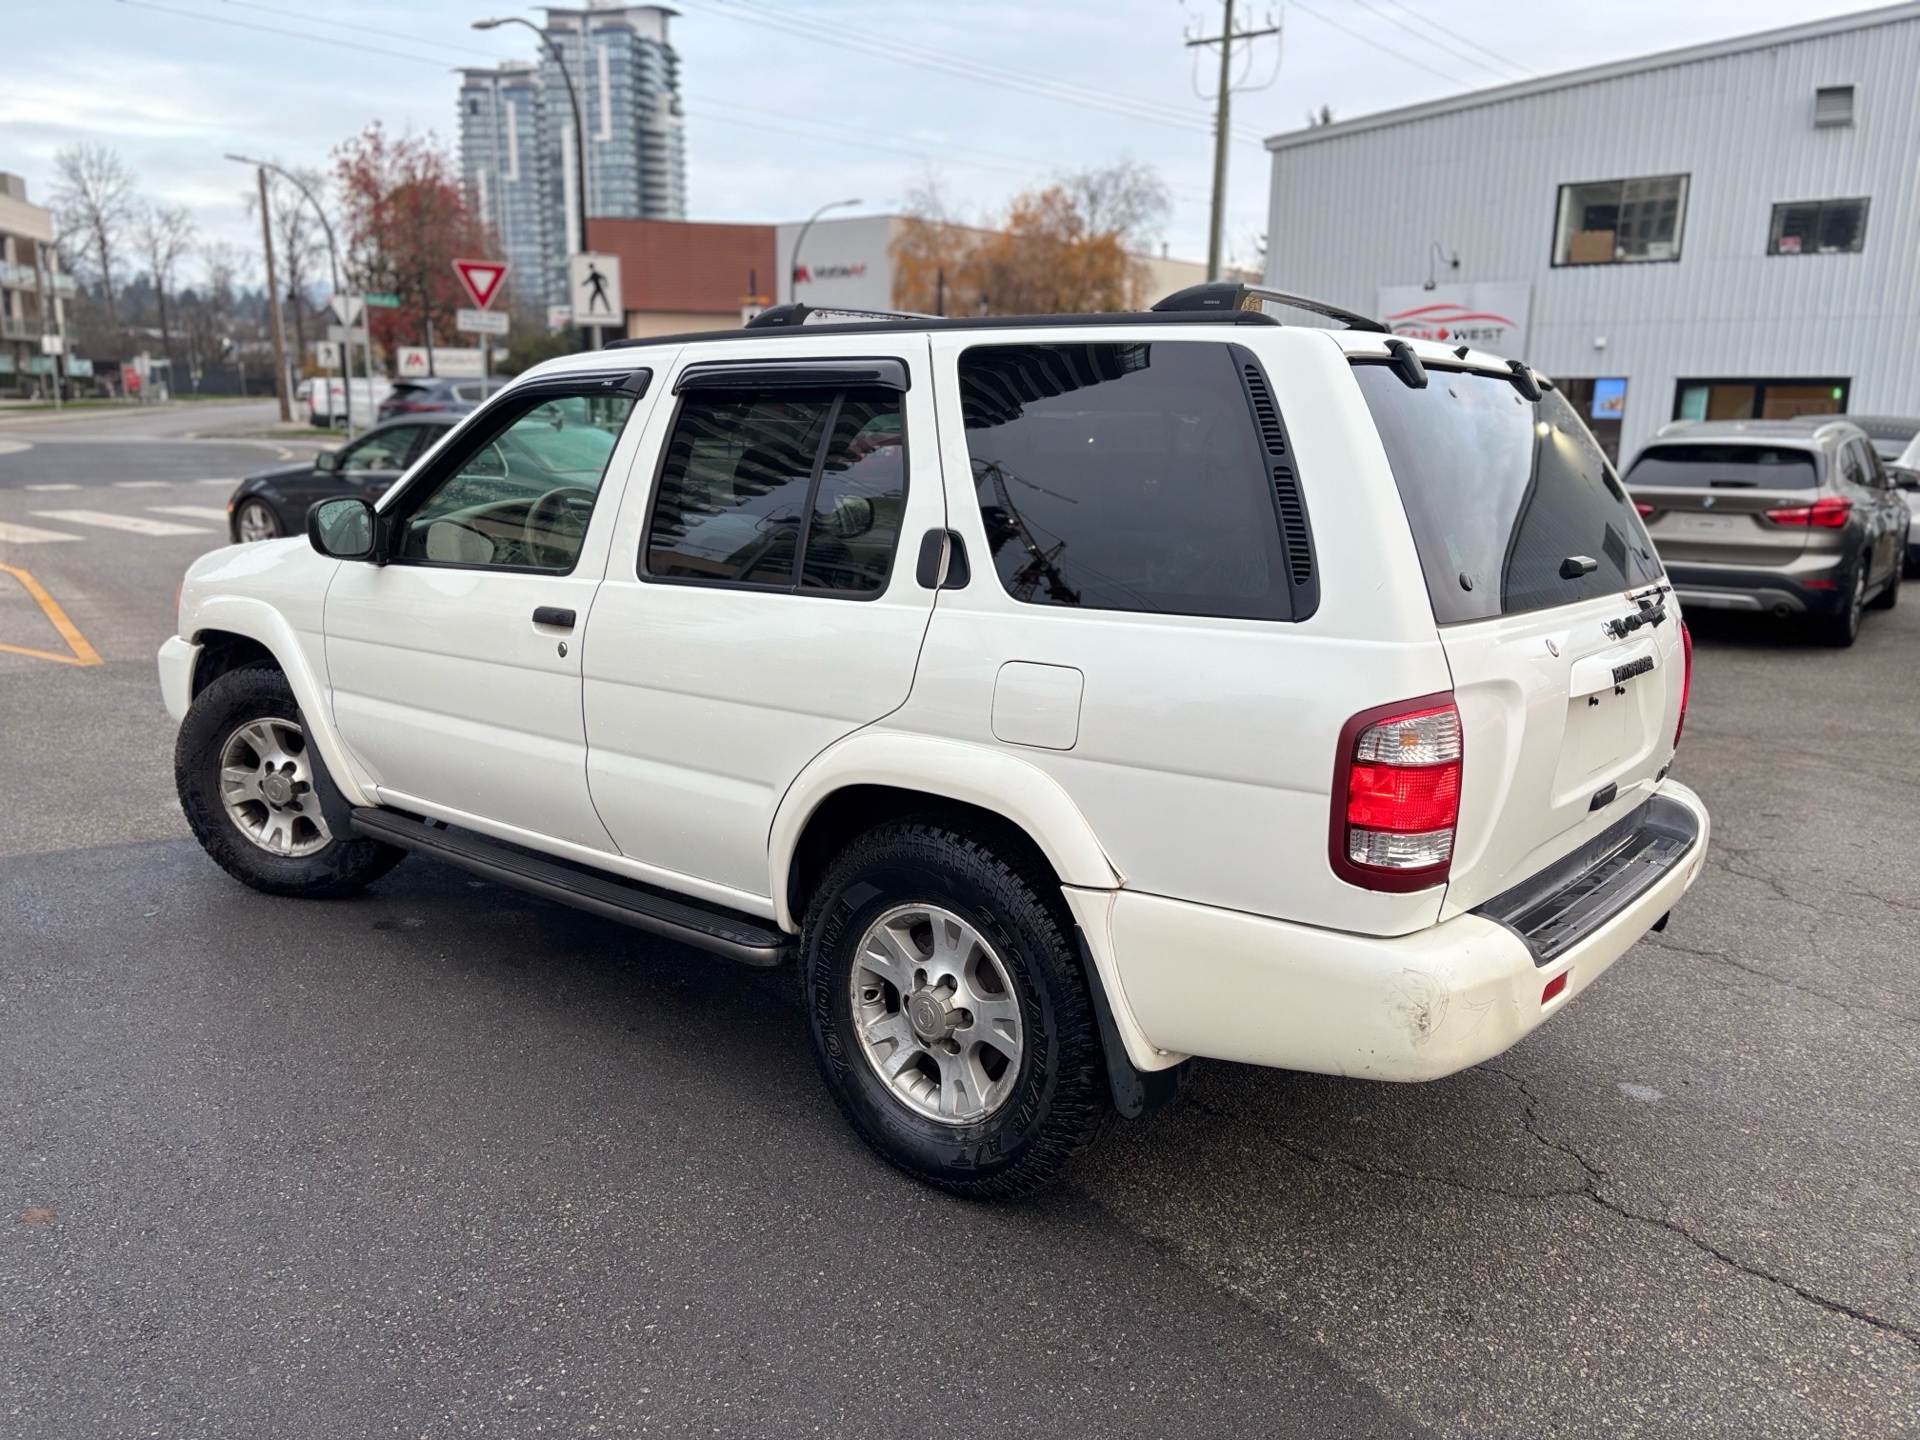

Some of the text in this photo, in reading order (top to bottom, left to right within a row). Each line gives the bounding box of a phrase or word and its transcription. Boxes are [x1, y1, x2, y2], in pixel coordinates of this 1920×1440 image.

[1453, 328, 1503, 340] WEST
[1612, 655, 1654, 685] PATHFINDER
[814, 897, 855, 1080] YOKOHAMA
[973, 905, 1047, 1136] GEOLANDAR
